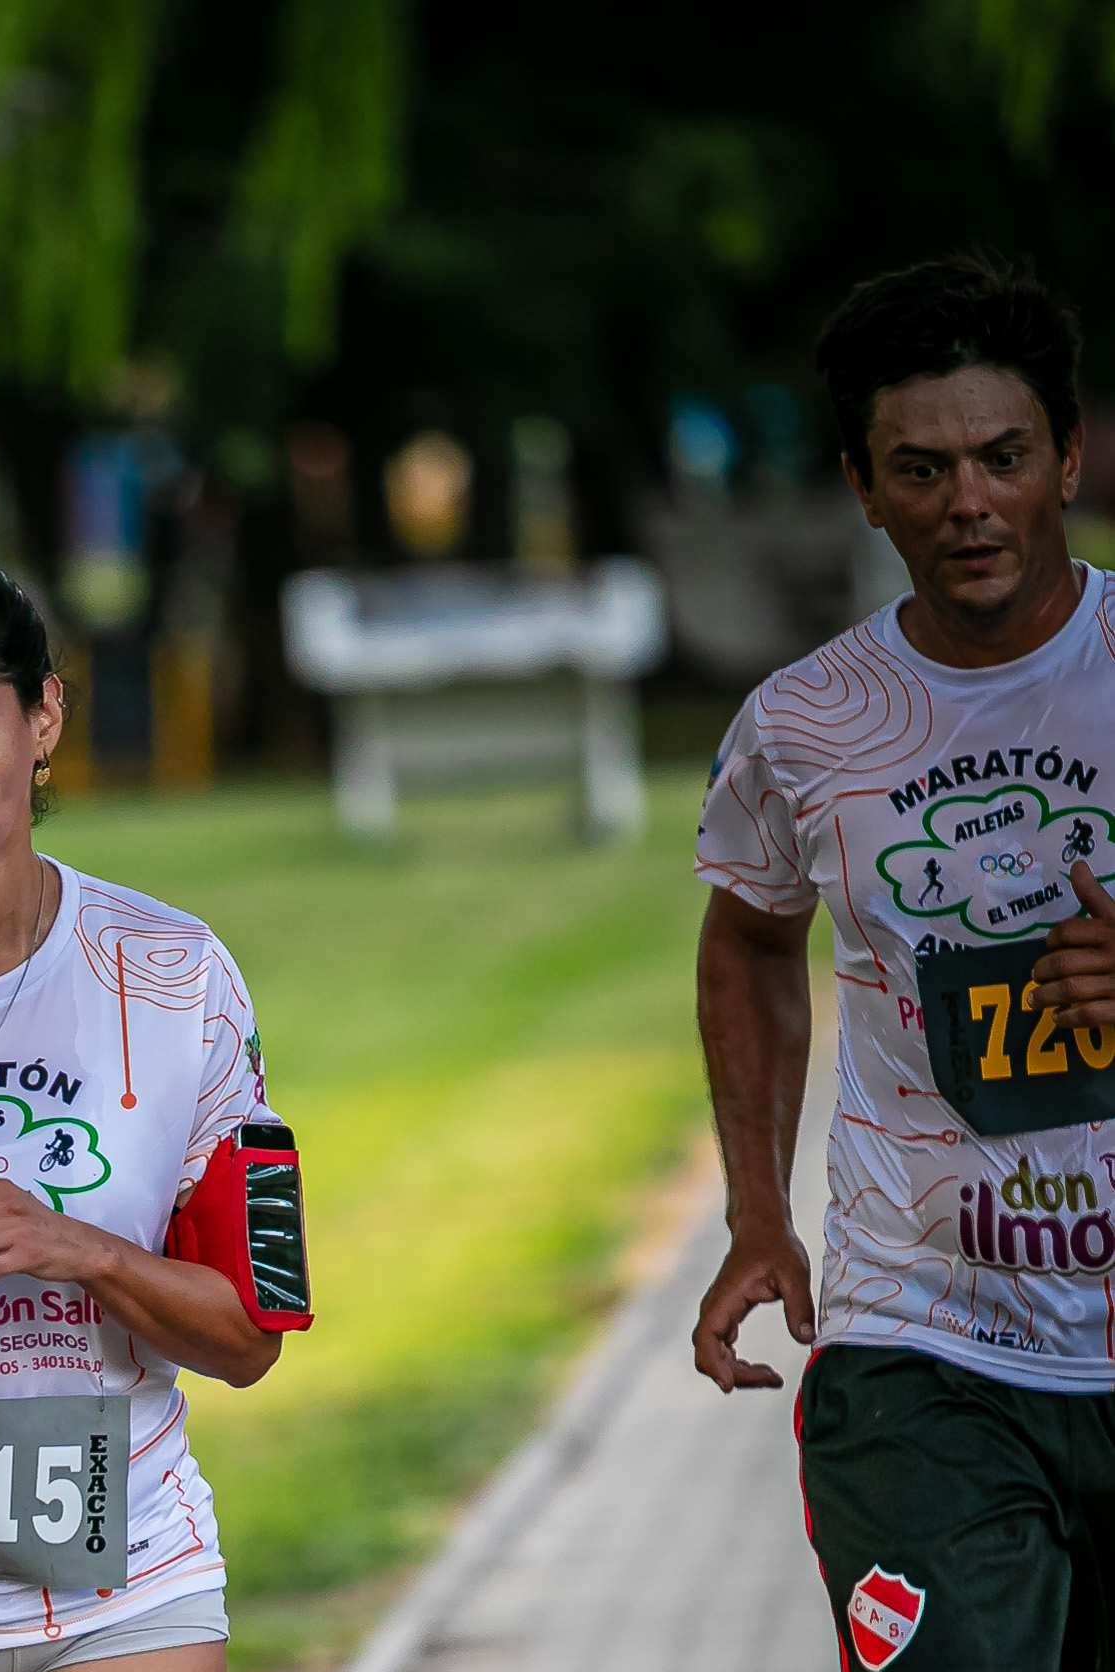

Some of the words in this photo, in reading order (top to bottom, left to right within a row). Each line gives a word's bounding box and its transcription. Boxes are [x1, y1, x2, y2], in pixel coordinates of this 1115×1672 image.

[888, 745, 1099, 816] MARATÓN
[954, 800, 1025, 843] ATLETAS
[987, 906, 1009, 925] EL
[1001, 1154, 1098, 1213] don
[41, 1290, 102, 1325] Sal
[0, 1332, 88, 1352] SEGUROS
[86, 1434, 109, 1554] EXACTO
